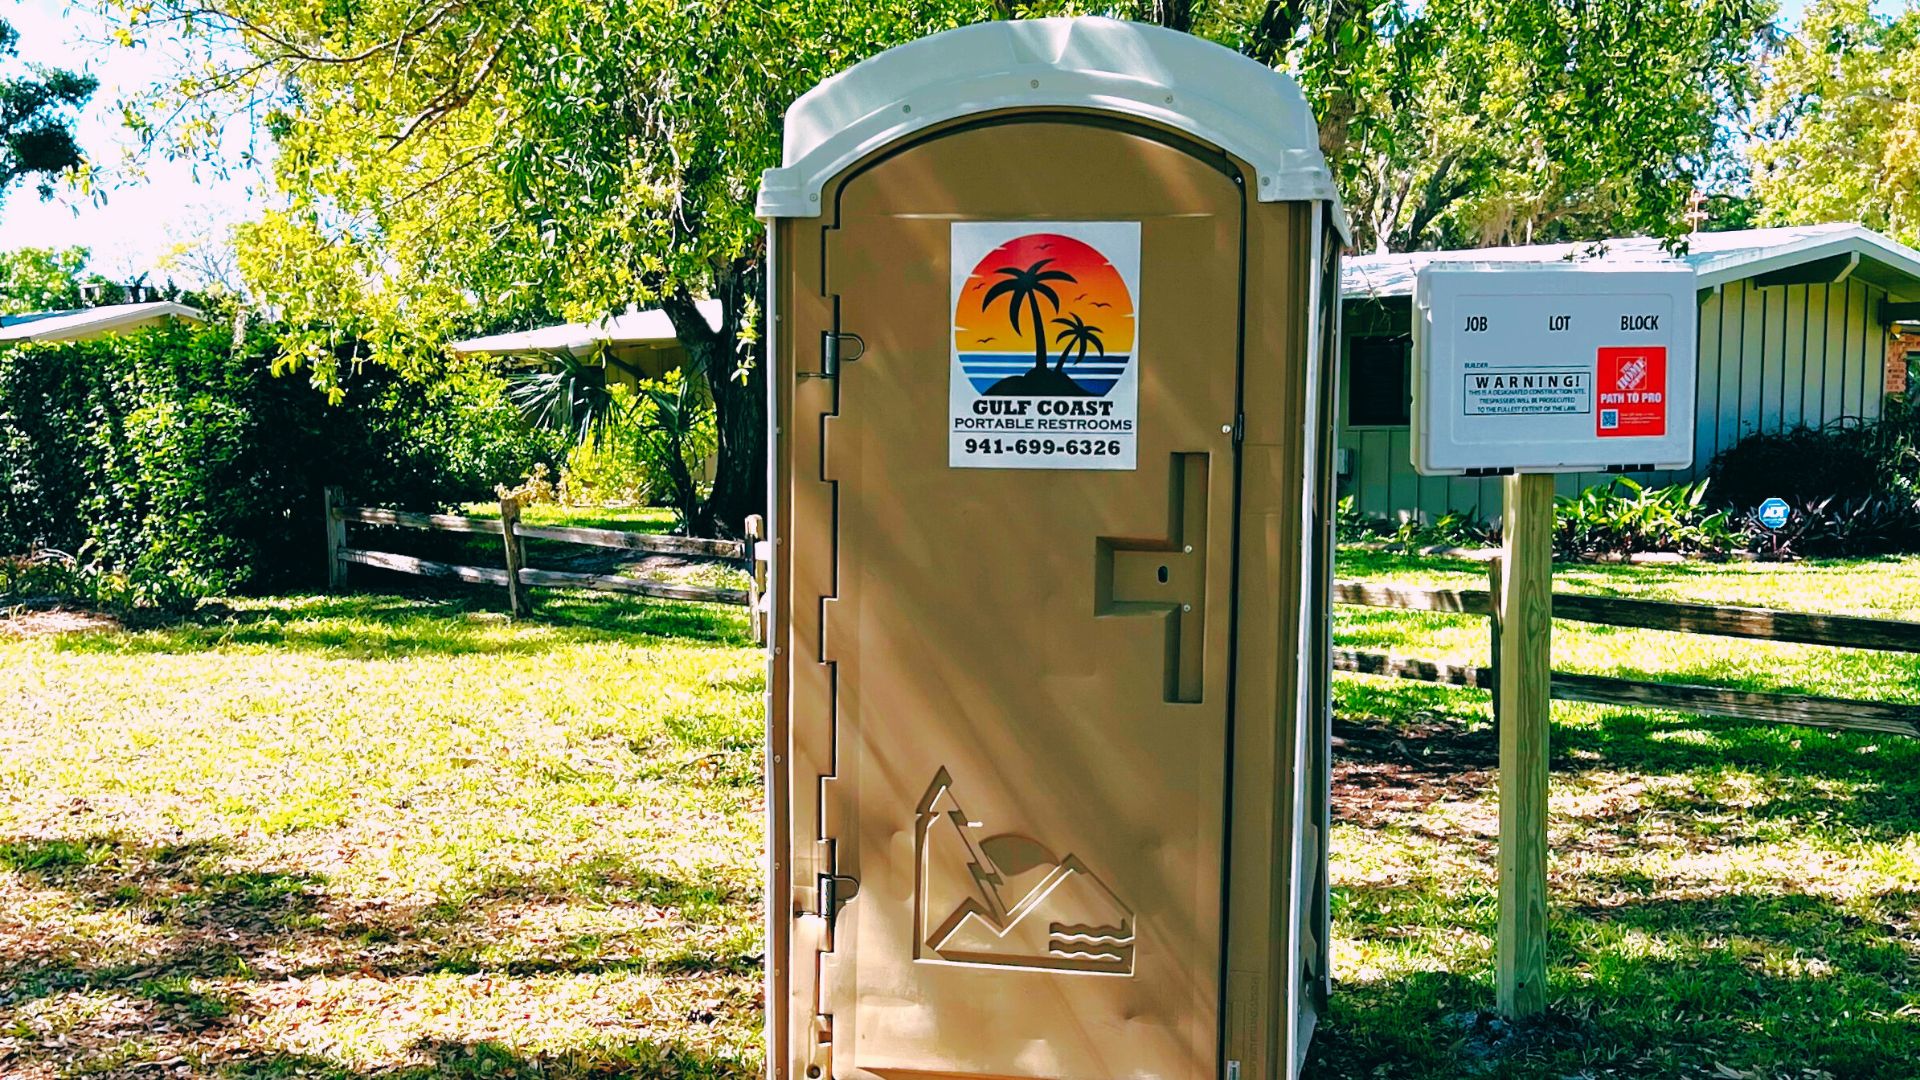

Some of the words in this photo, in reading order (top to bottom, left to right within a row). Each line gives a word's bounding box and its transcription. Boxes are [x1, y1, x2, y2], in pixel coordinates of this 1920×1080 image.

[1464, 316, 1488, 332] JOB
[1549, 315, 1571, 331] LOT
[1620, 315, 1659, 331] BLOCK
[1616, 357, 1645, 390] HOME
[1475, 375, 1580, 388] WARNING!
[1600, 393, 1624, 404] PATH
[1626, 392, 1639, 403] TO
[1641, 392, 1662, 403] PRO
[972, 400, 1032, 416] GULF
[1037, 400, 1114, 416] COAST
[954, 418, 1035, 430] PORTABLE
[1037, 418, 1133, 431] RESTROOMS
[965, 438, 1121, 456] 941-699-6326
[1763, 506, 1787, 518] ADT
